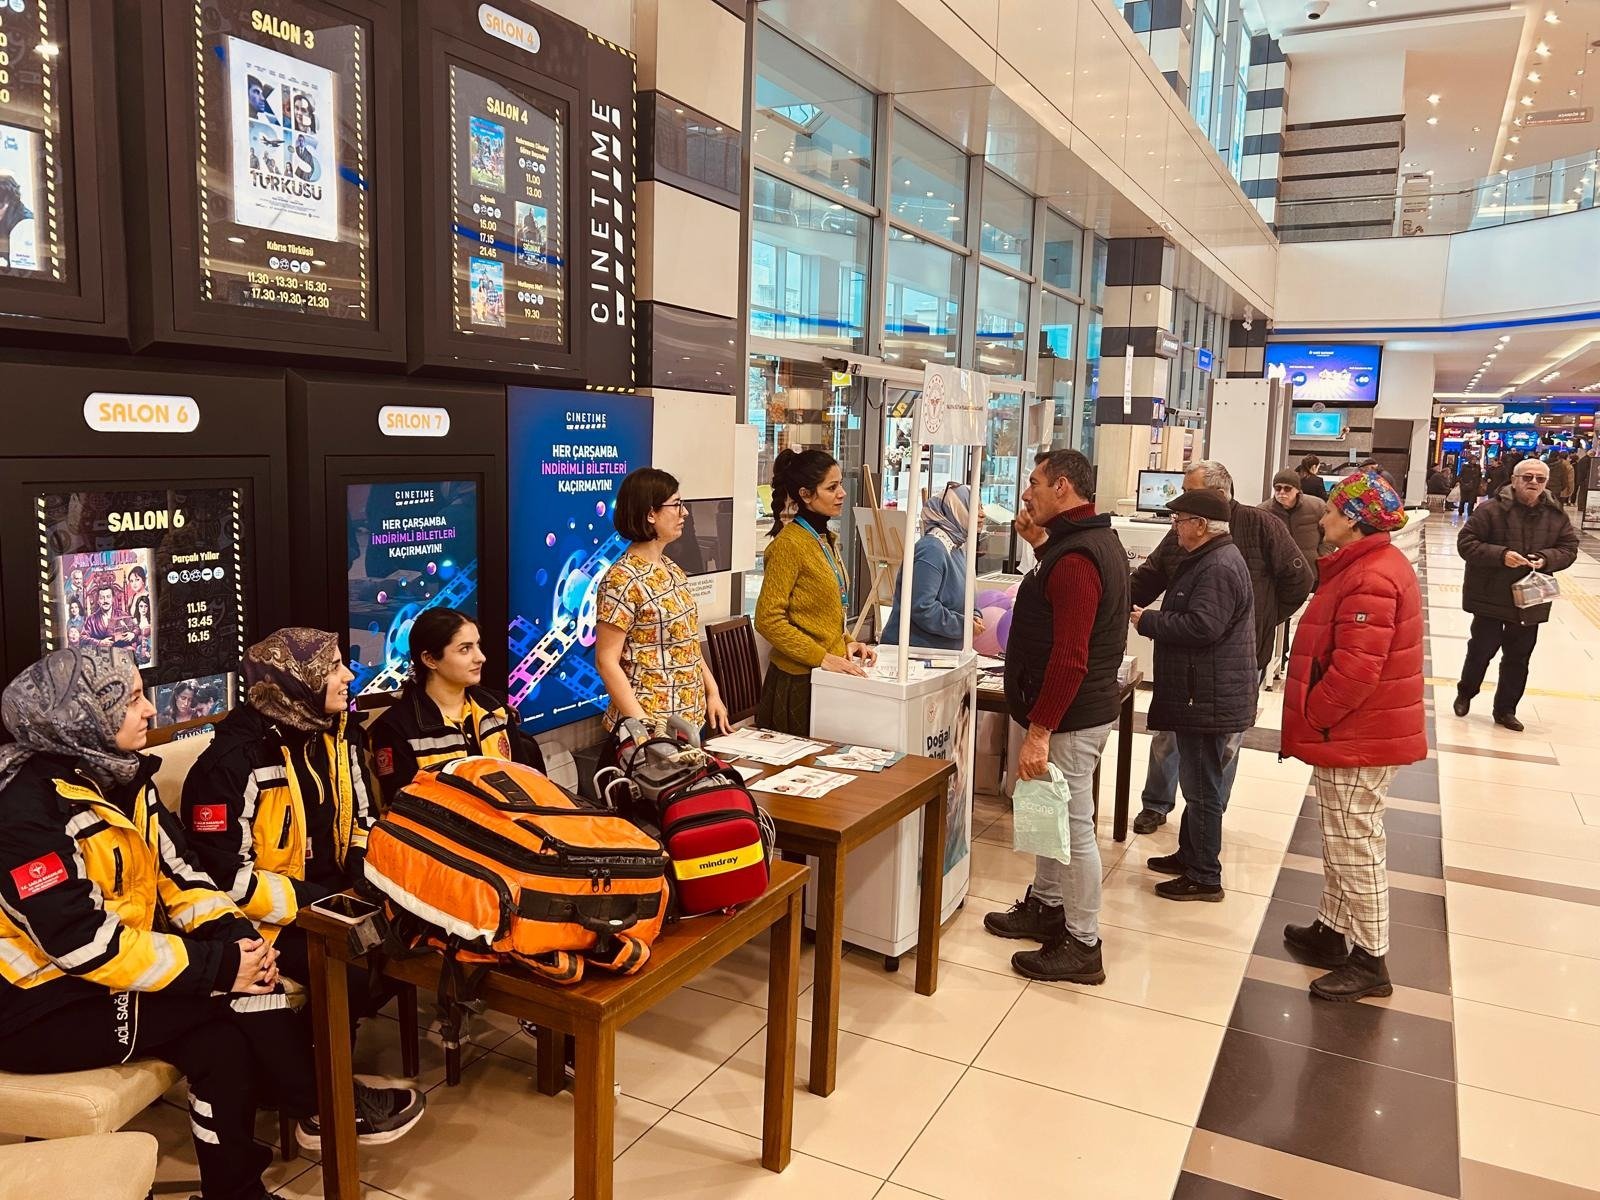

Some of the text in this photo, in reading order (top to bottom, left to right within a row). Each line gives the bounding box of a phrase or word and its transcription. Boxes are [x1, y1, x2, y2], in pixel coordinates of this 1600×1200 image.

[251, 9, 315, 50] SALON 3
[485, 14, 534, 46] SALON 4
[487, 97, 529, 126] SALON 4
[525, 173, 541, 186] 11.00
[526, 186, 542, 199] 13.00
[591, 99, 610, 323] CINETIME
[480, 218, 497, 232] 15.00
[266, 240, 287, 252] Kıbrıs
[480, 232, 494, 245] 17.15
[480, 246, 497, 259] 21.45
[247, 271, 327, 293] 11.30 13.30 15.30
[251, 287, 275, 301] 17.30
[307, 294, 329, 309] 21.30
[524, 308, 540, 320] 19.30
[99, 402, 188, 423] SALON 6
[566, 412, 607, 423] CINETIME
[386, 413, 442, 429] SALON 7
[552, 444, 618, 460] HER ÇARŞAMBA
[542, 460, 627, 475] İNDİRİMLİ BİLETLERİ
[558, 479, 612, 494] KAÇIRMAYIN!
[395, 490, 434, 499] CINETIME
[108, 509, 185, 532] SALON 6
[382, 516, 447, 532] HER ÇARŞAMBA
[372, 528, 456, 545] İNDİRİMLİ BİLETLERİ
[172, 551, 219, 564] Parçalı Yıllar
[389, 543, 442, 558] KAÇIRMAYIN!
[187, 601, 207, 614] 11.15
[188, 615, 213, 629] 13.45
[187, 630, 210, 644] 16.15
[699, 856, 739, 870] mindray
[114, 1022, 129, 1045] ACİL
